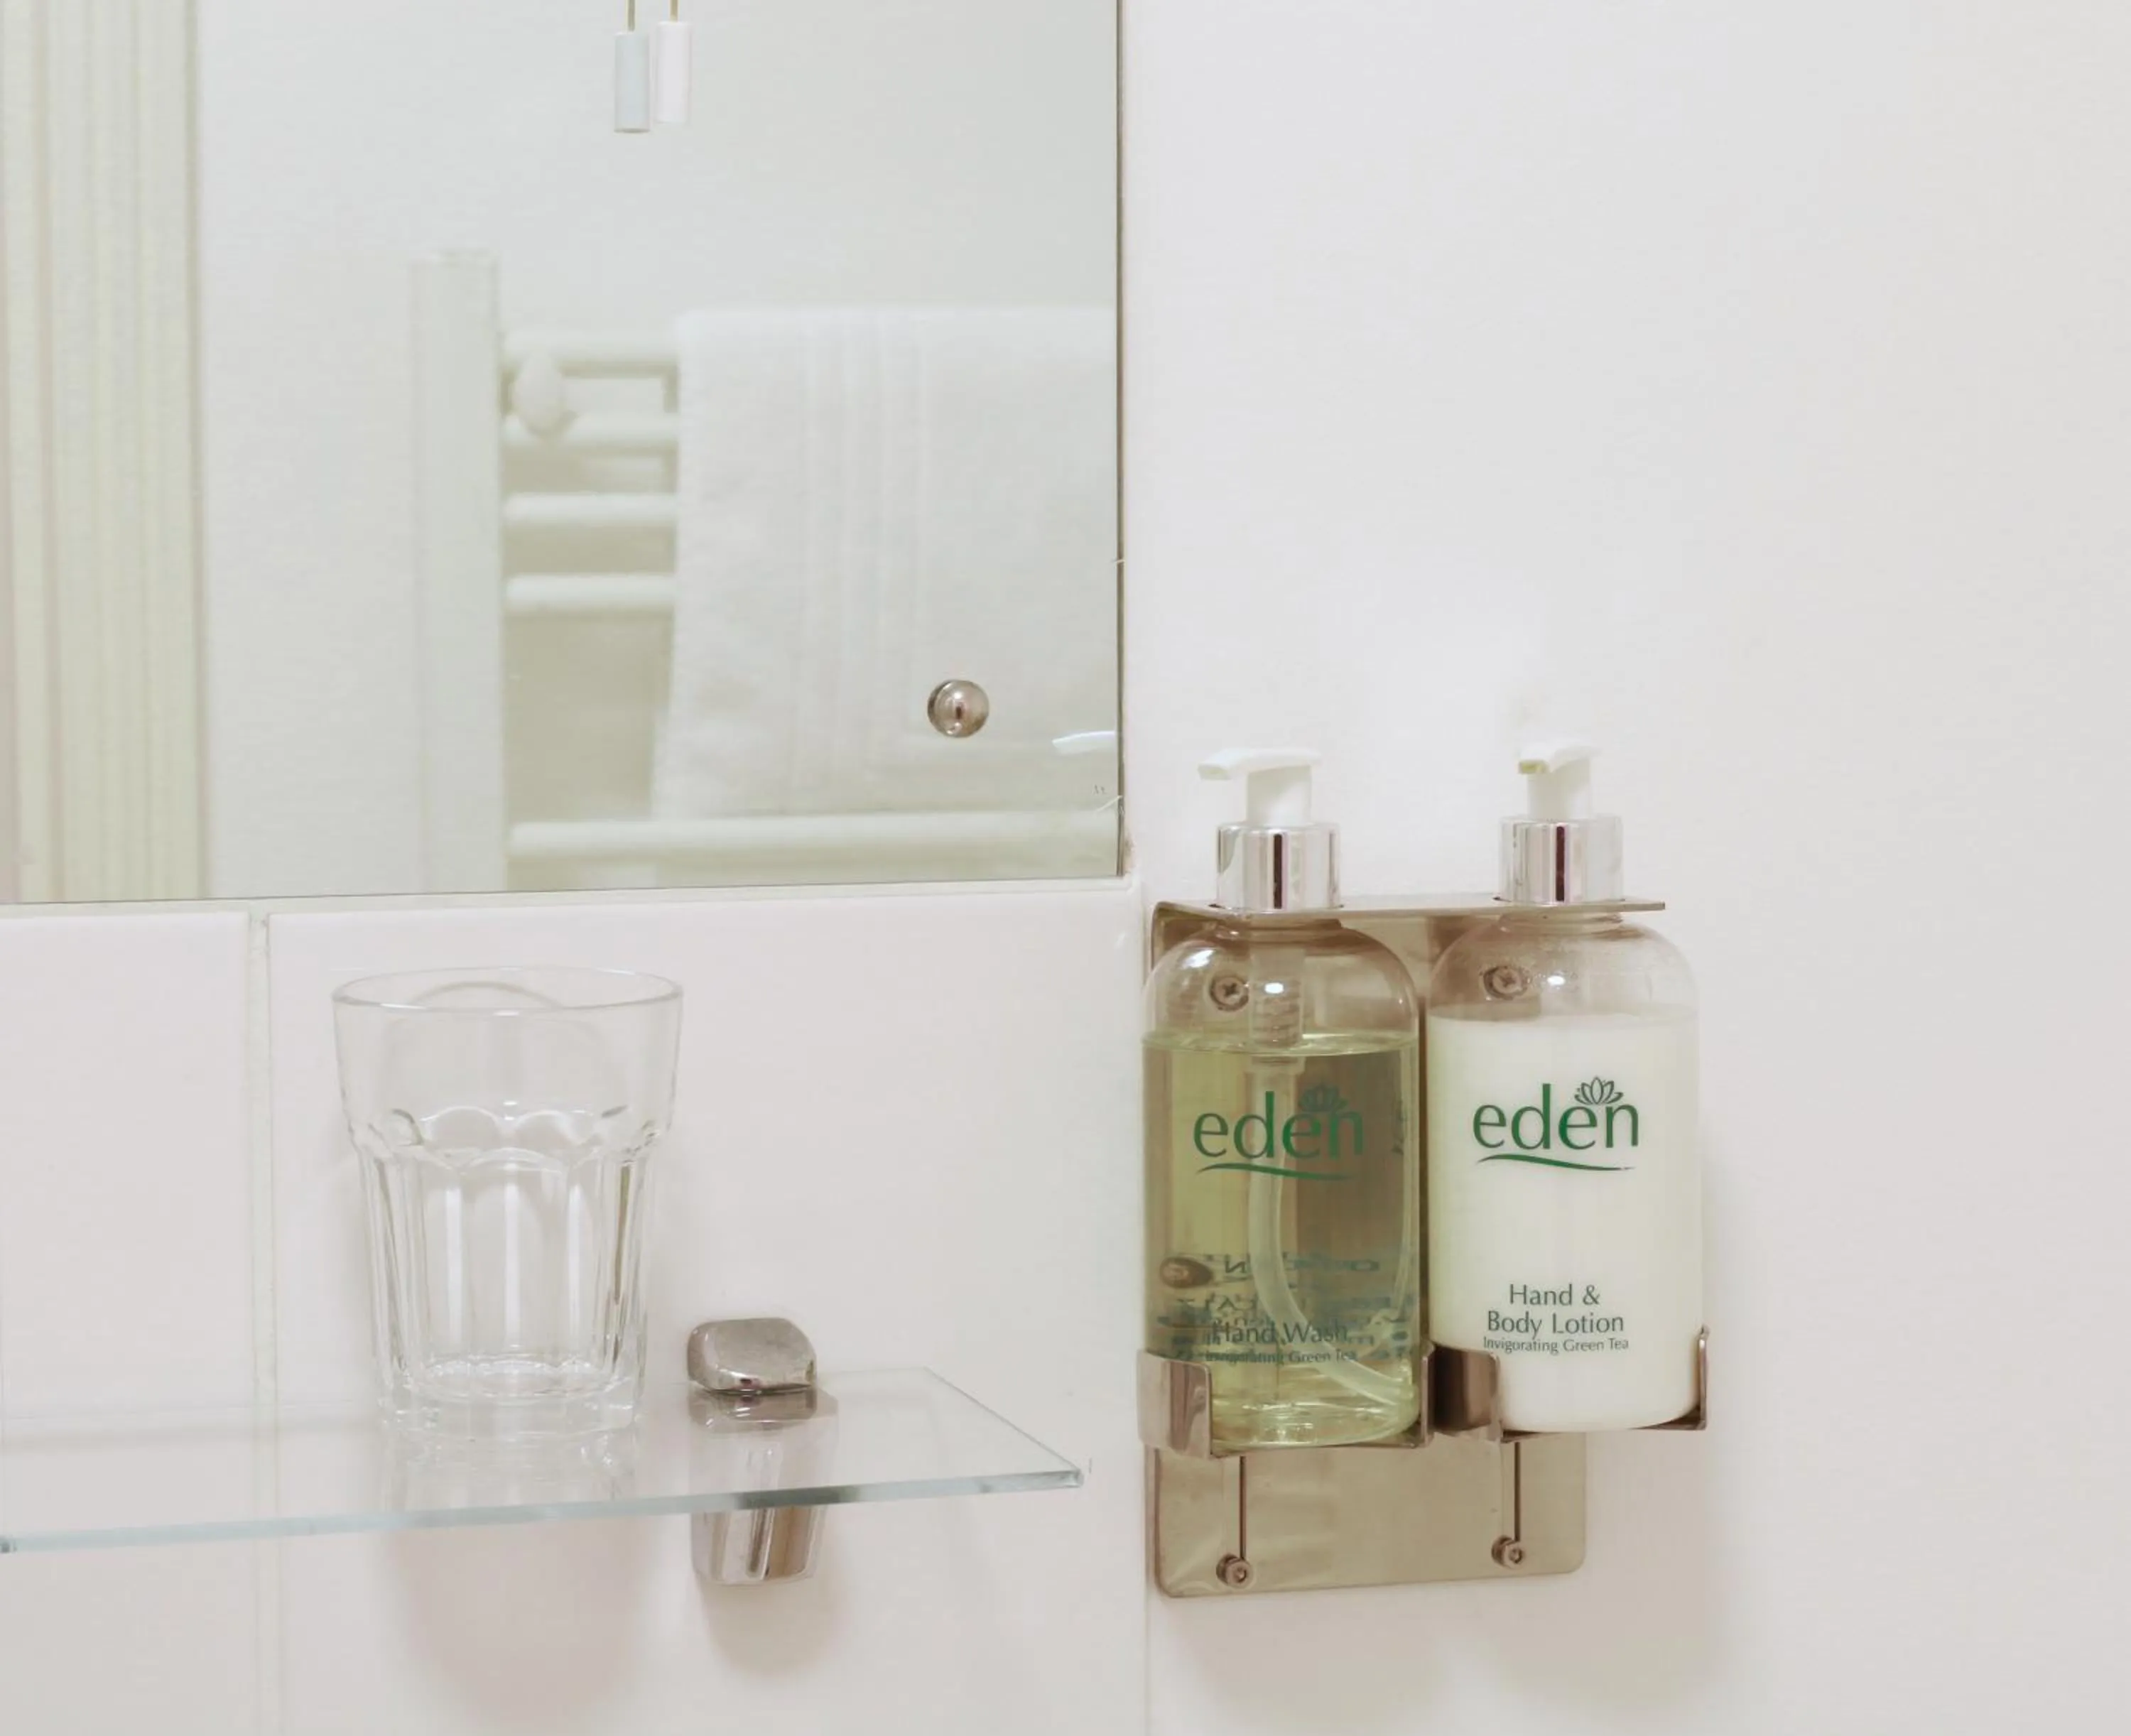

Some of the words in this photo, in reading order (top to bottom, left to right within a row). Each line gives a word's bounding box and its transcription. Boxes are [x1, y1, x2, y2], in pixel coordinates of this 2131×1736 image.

[1193, 1090, 1363, 1159] eden
[1473, 1083, 1639, 1150] eden
[1509, 1284, 1573, 1306] Hand
[1583, 1284, 1601, 1306] &
[1212, 1318, 1276, 1342] Hand
[1281, 1320, 1349, 1343] Wash
[1487, 1311, 1542, 1339] Body
[1552, 1312, 1624, 1334] Lotion
[1289, 1350, 1331, 1363] Green
[1483, 1337, 1558, 1354] Invigorating
[1563, 1338, 1605, 1352] Green
[1608, 1338, 1630, 1350] Tea
